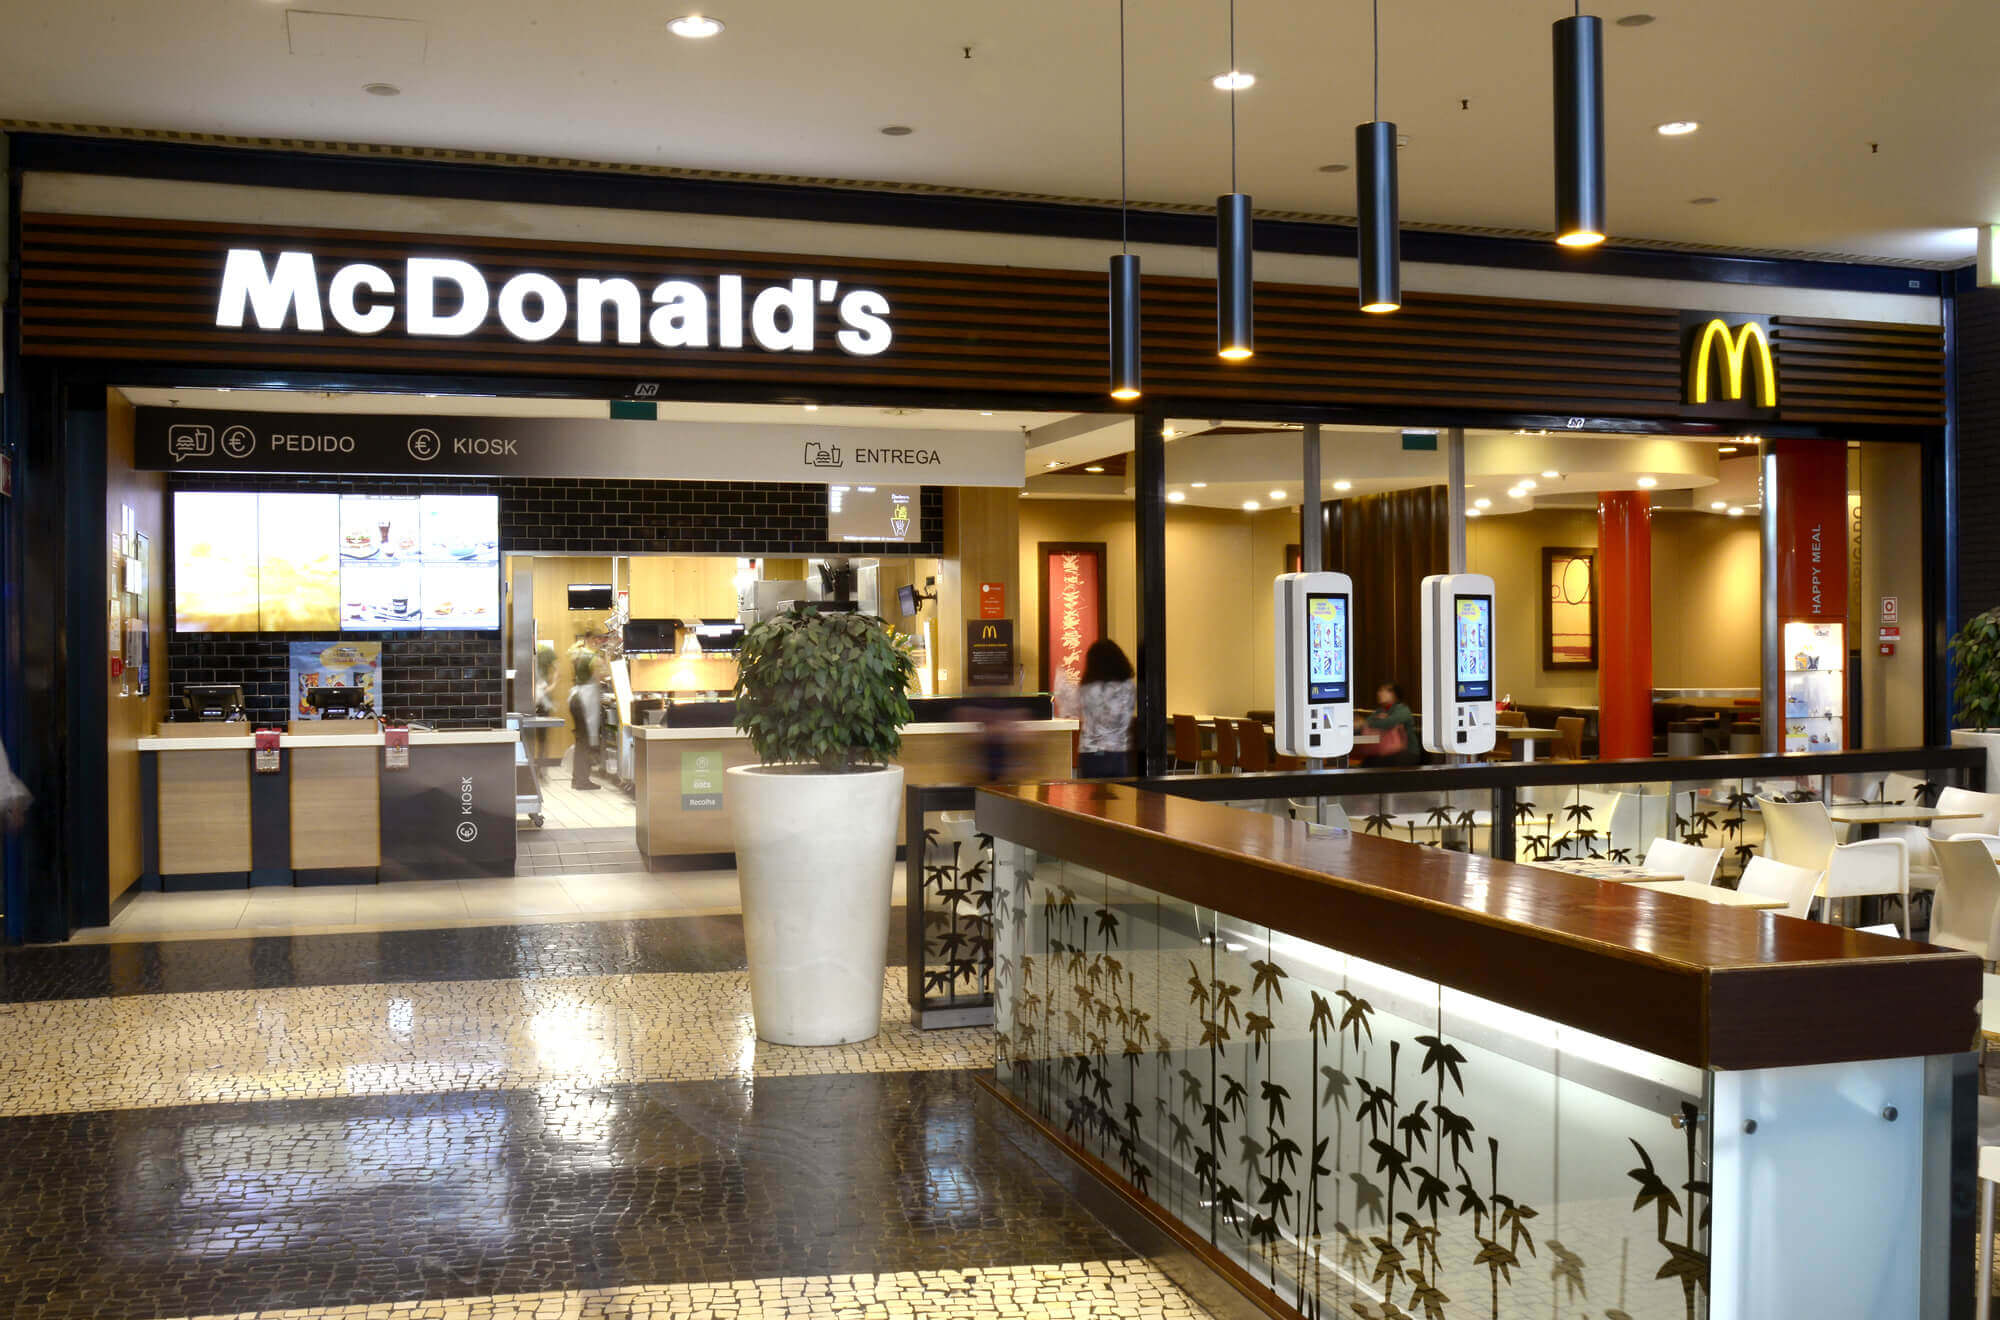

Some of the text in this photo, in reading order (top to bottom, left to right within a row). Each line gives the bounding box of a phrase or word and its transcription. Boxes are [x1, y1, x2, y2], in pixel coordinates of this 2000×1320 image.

[215, 248, 893, 356] McDonald's
[271, 434, 356, 453] PEDIDO
[453, 437, 519, 456] KIOSK
[855, 448, 941, 465] ENTREGA
[1811, 523, 1822, 615] HAPPY MEAL
[460, 776, 473, 815] KIOSK
